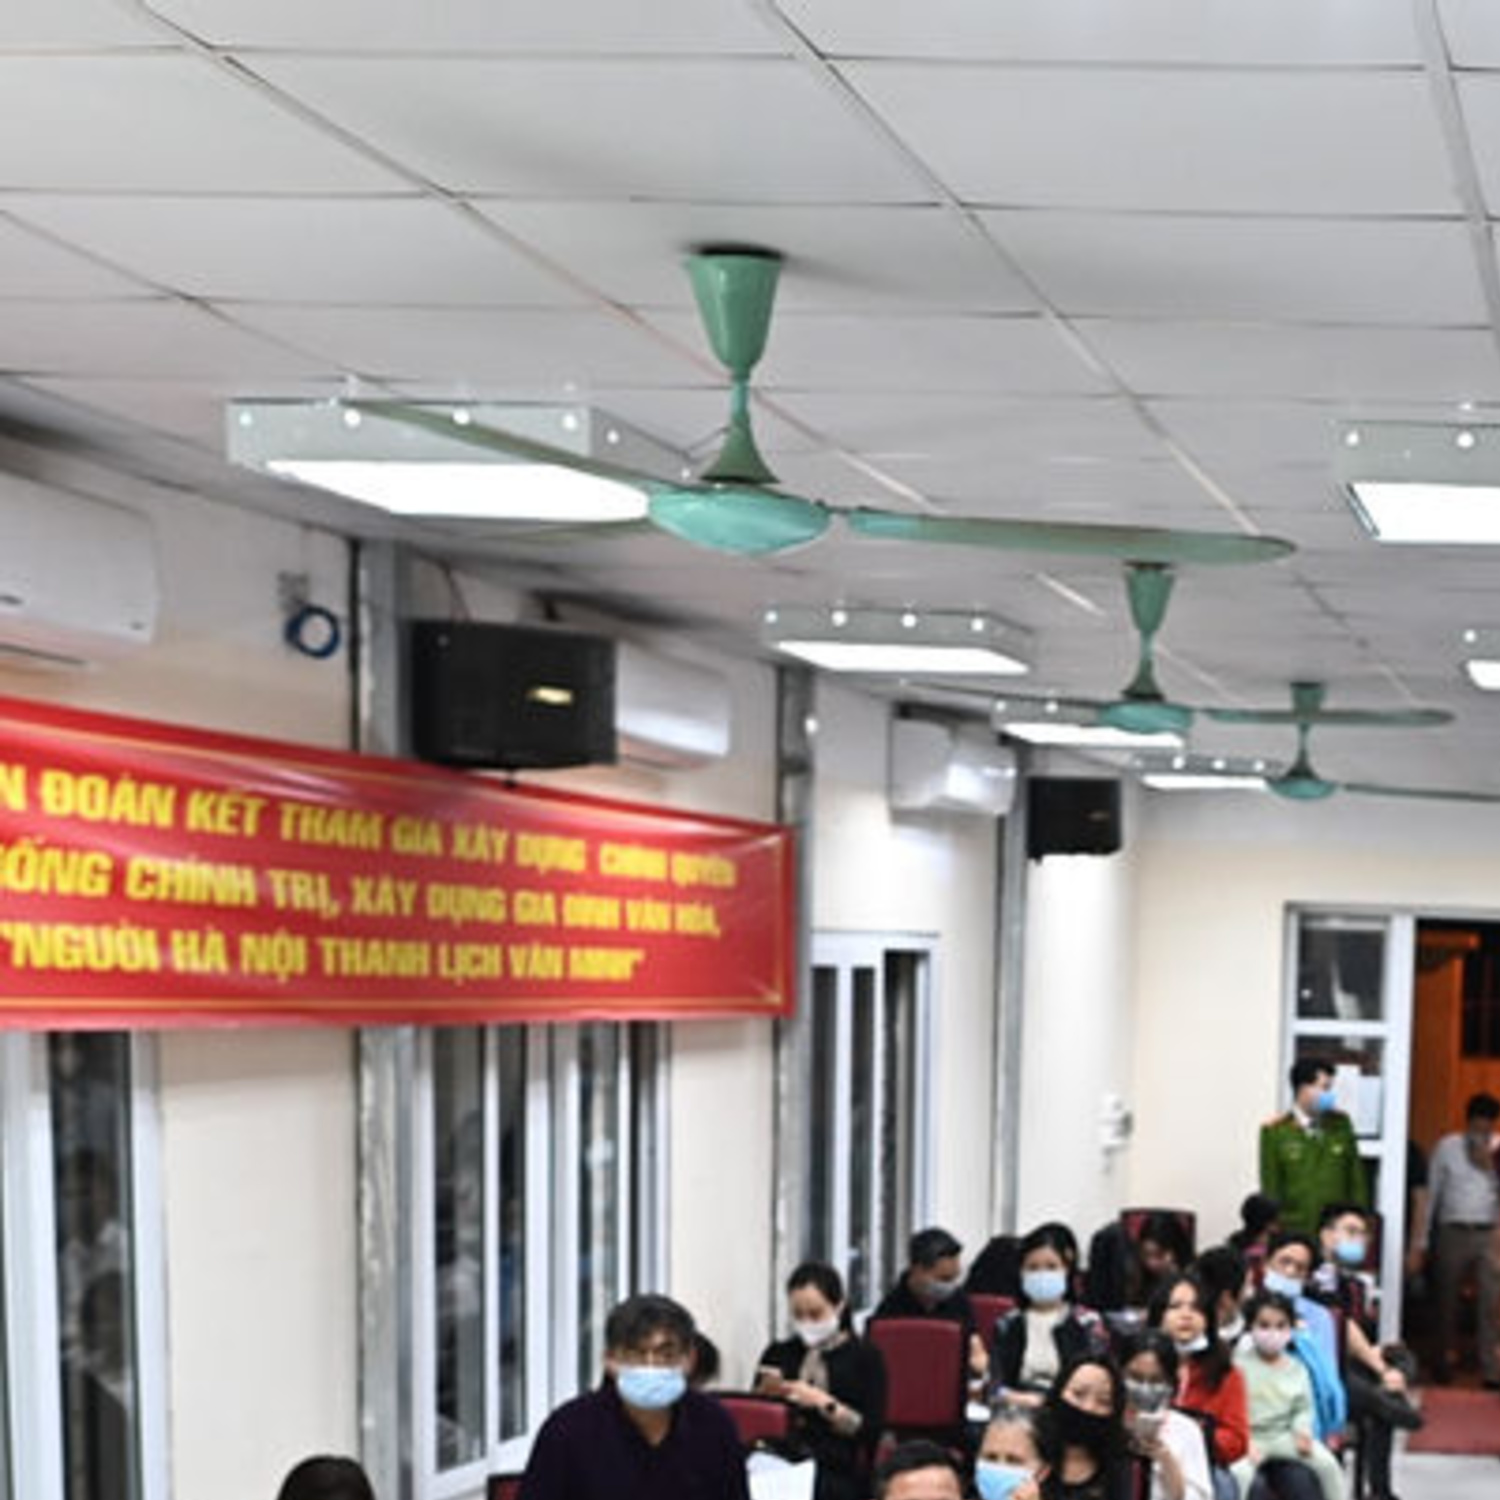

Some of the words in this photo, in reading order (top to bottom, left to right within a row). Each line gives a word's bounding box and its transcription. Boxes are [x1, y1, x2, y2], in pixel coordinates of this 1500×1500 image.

[41, 768, 175, 827] ĐOÀN
[186, 788, 266, 836] KẾT
[280, 802, 384, 850] THAM
[392, 816, 442, 856] GIA
[453, 822, 508, 864] XÂY
[0, 836, 112, 898] ỐNG
[125, 852, 257, 906] CHÍNH
[268, 868, 340, 920] TRỊ,
[352, 874, 417, 917] XÂY
[427, 882, 507, 928] DỰNG
[513, 889, 556, 926] GIA
[170, 924, 229, 974] HÀ
[239, 927, 306, 984] NỘI
[319, 937, 429, 977] THANH
[438, 942, 500, 986] LỊCH
